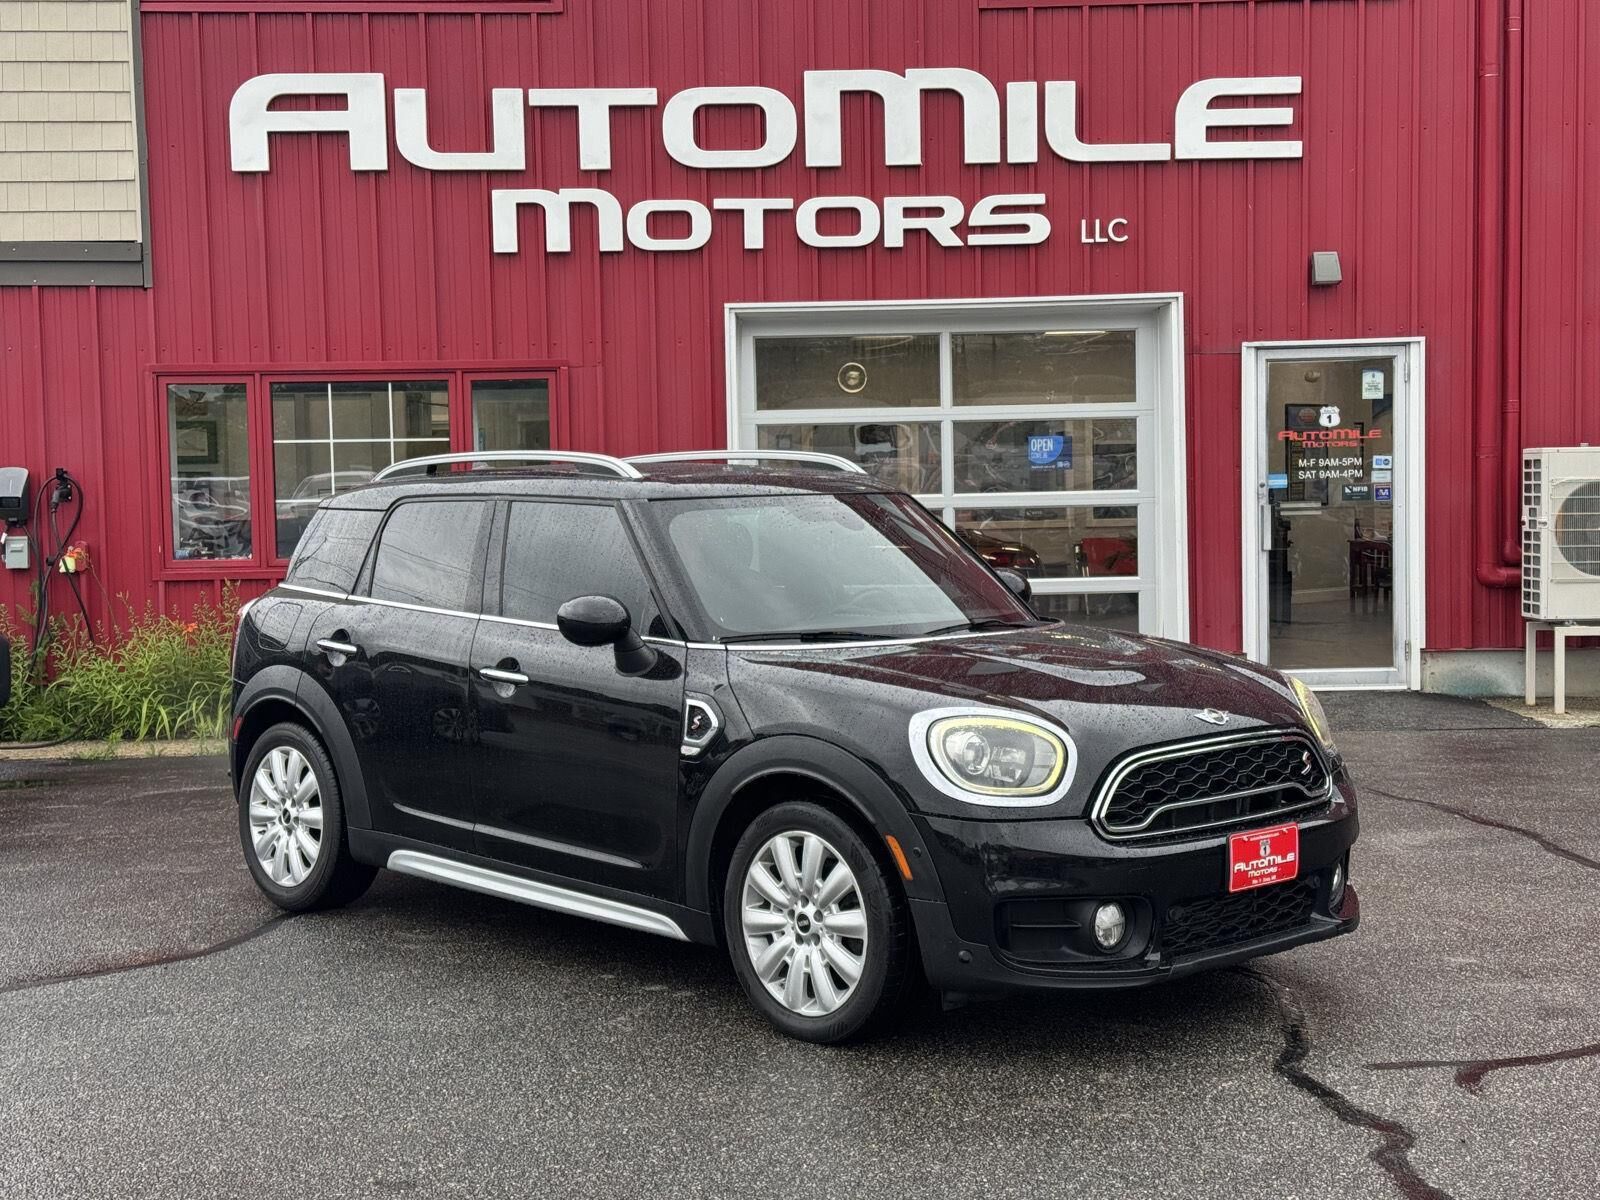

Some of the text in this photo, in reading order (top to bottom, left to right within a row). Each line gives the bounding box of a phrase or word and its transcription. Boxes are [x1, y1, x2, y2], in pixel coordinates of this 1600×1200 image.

[229, 68, 1303, 172] AUTOMILE
[491, 187, 1129, 253] MOTORS LLC
[1326, 414, 1332, 424] 1
[1277, 427, 1382, 441] AUTOMILE
[1030, 438, 1054, 451] OPEN
[1302, 440, 1358, 448] MOTORS
[1298, 457, 1362, 468] M-F 9AM-5PM
[1298, 470, 1316, 479] SAT
[1319, 469, 1363, 479] 9AM-4PM
[1234, 852, 1295, 873] AUTOMILE
[1248, 866, 1278, 878] MOTORS
